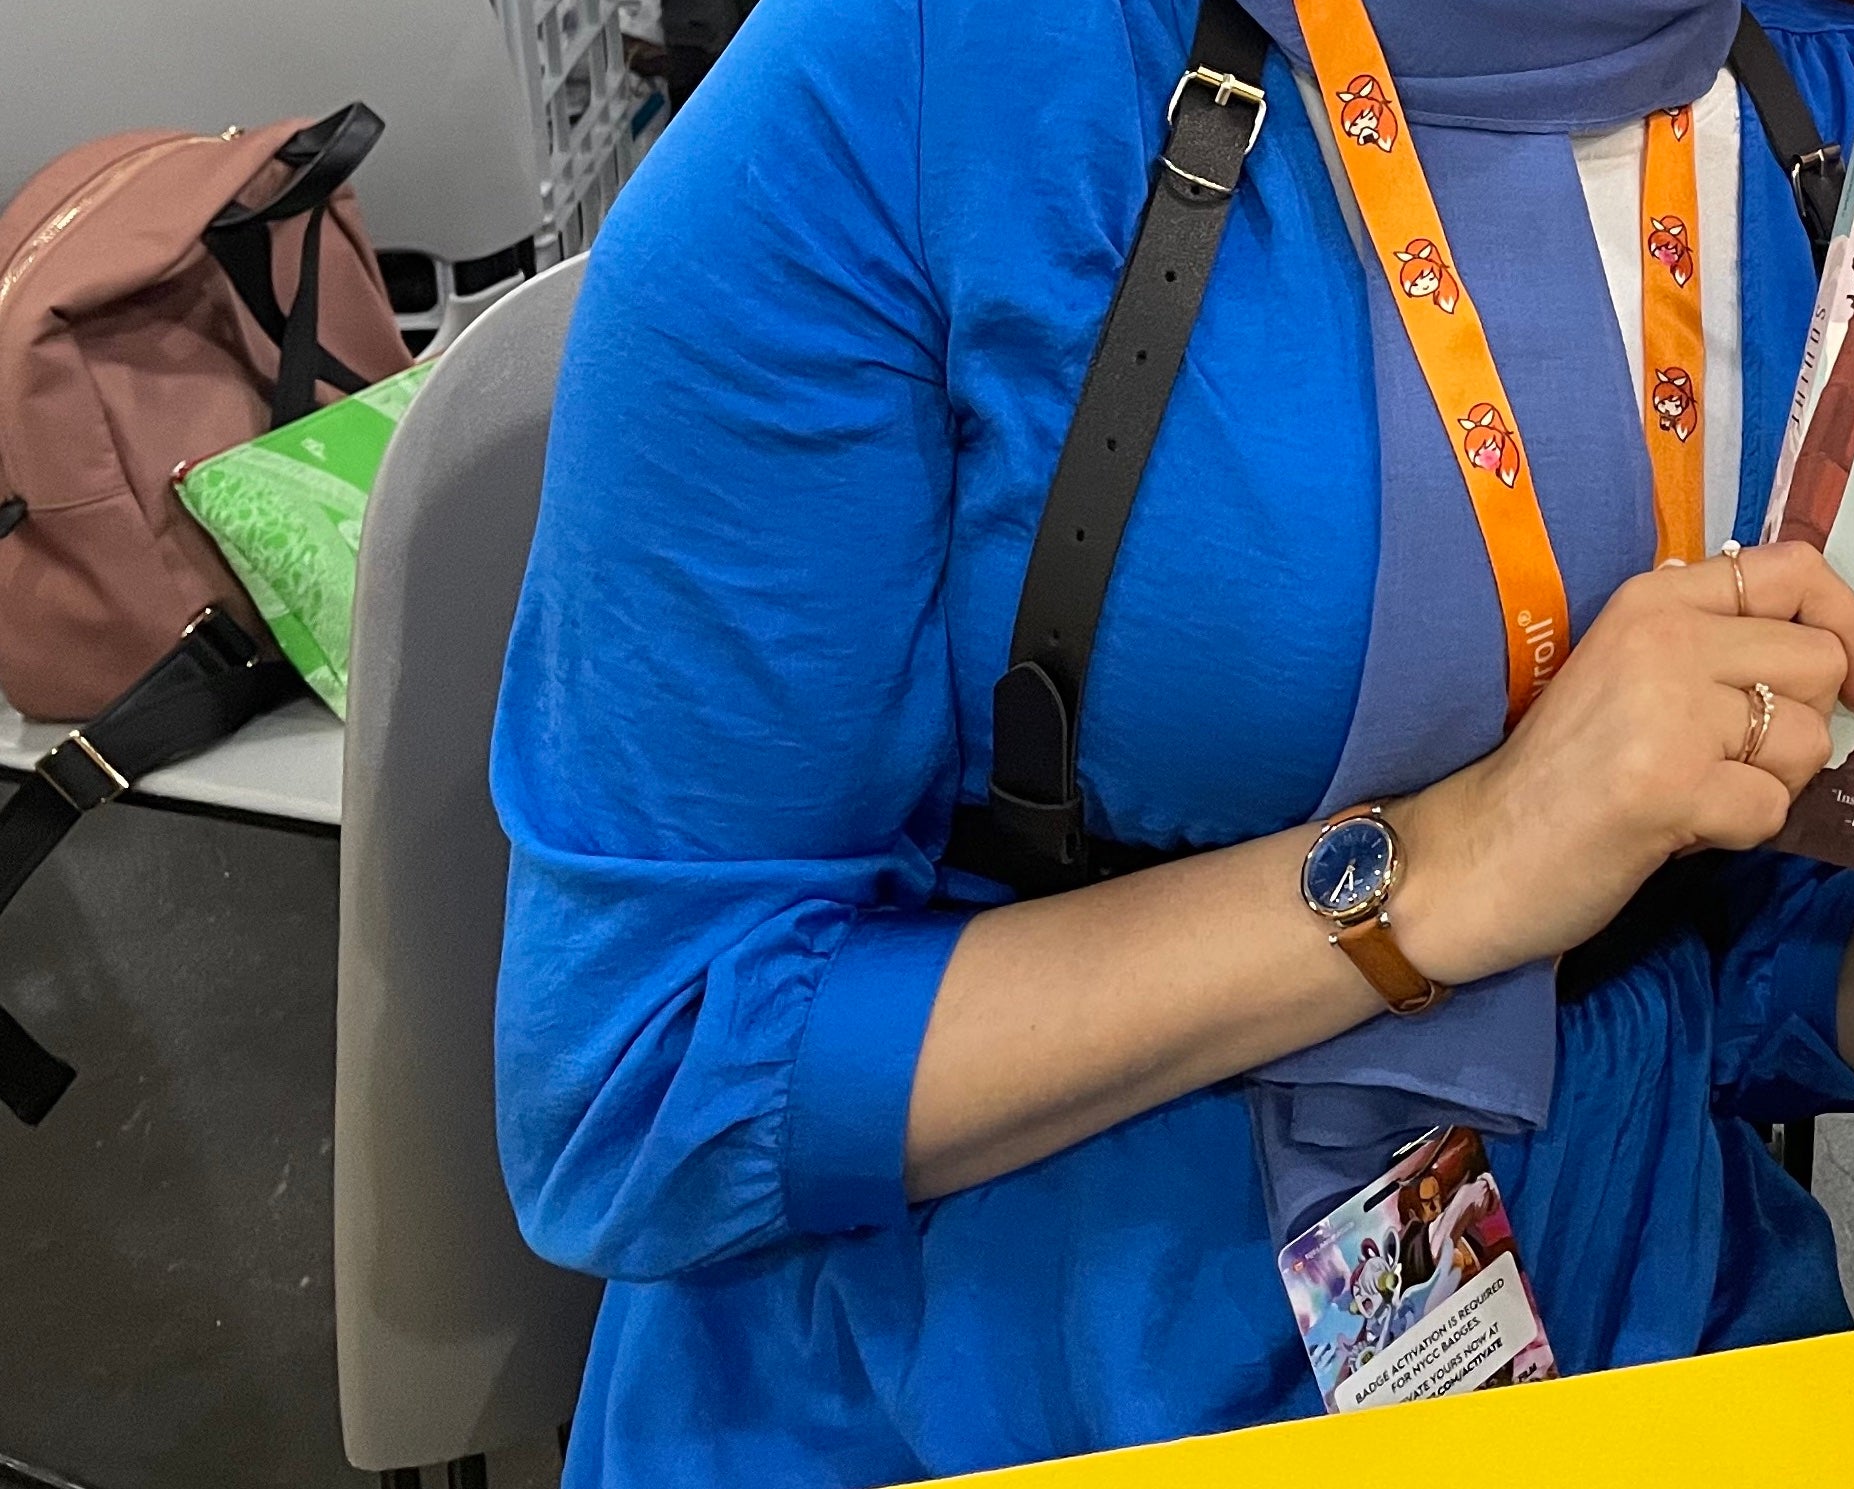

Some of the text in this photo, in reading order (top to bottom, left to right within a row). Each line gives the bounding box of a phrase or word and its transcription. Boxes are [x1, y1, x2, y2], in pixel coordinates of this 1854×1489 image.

[1355, 1278, 1504, 1404] BADGE ACTIVATION IS REQUIRED
[1391, 1372, 1412, 1393] FOR
[1412, 1348, 1440, 1376] NYCC
[1430, 1353, 1463, 1384] YOURS
[1464, 1332, 1487, 1358] NOW
[1488, 1322, 1500, 1339] AT
